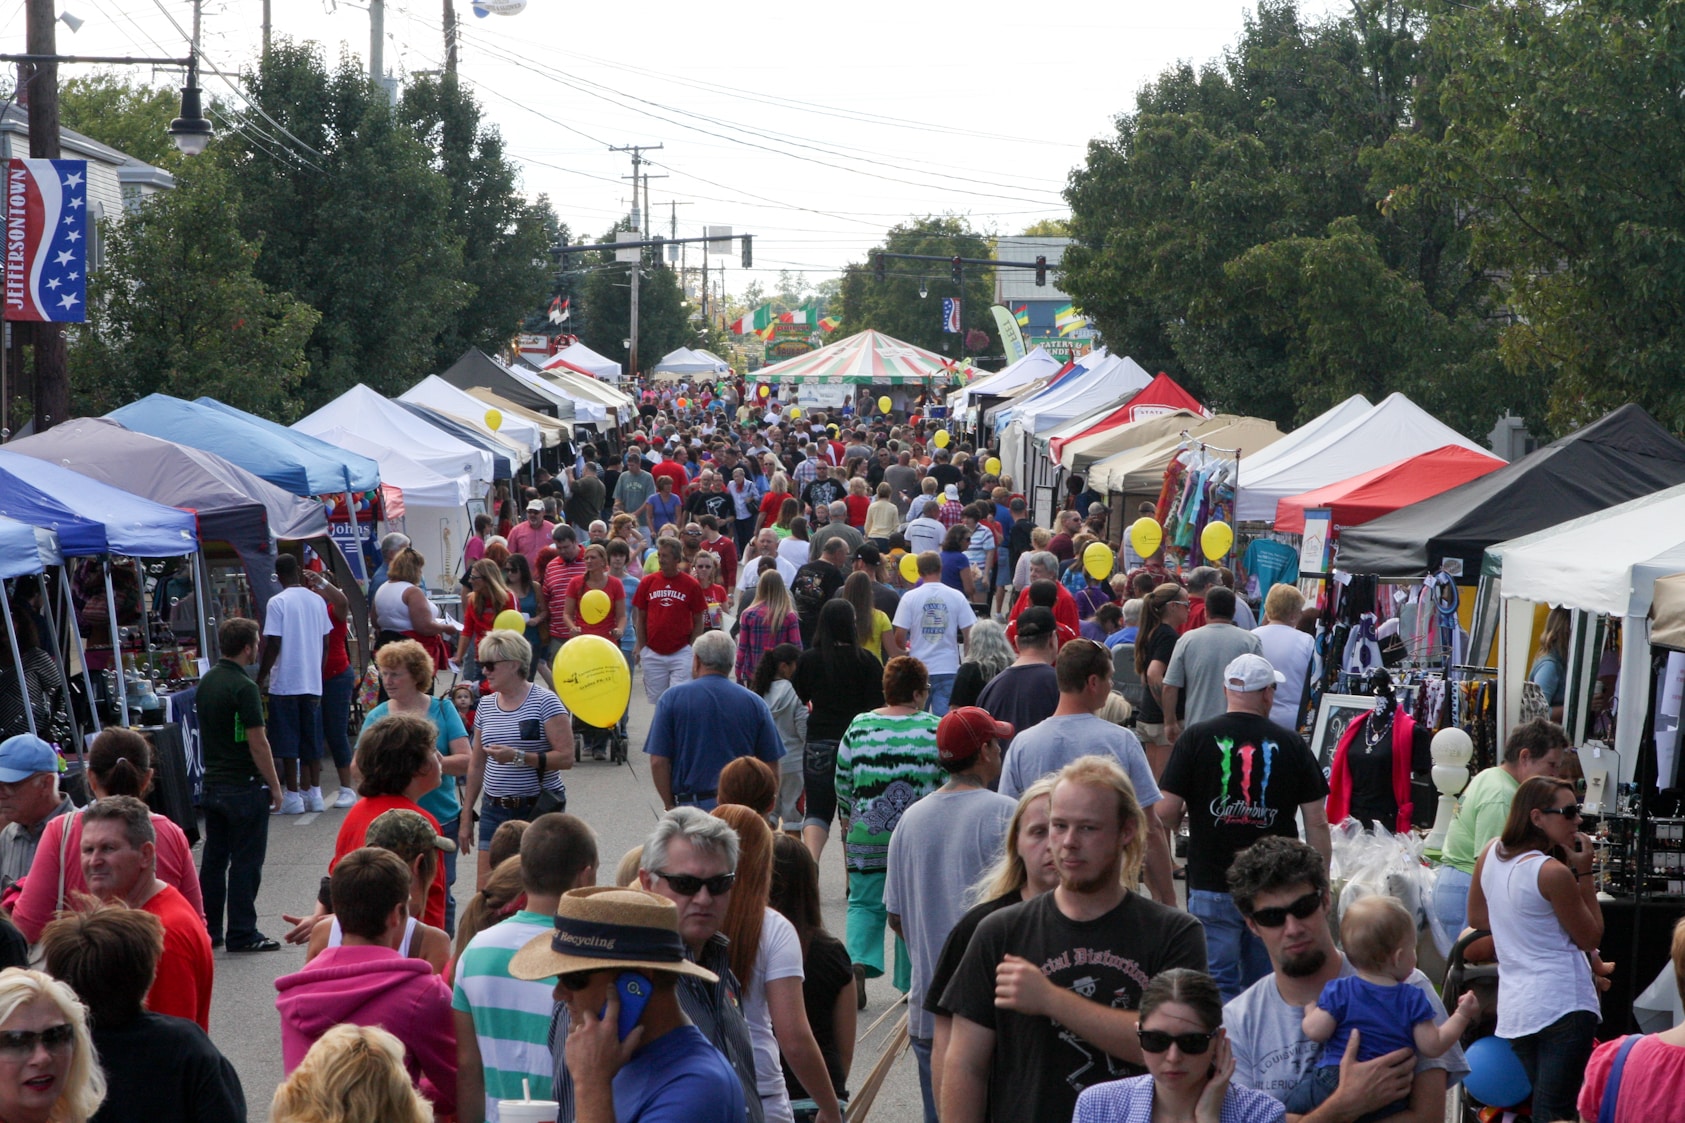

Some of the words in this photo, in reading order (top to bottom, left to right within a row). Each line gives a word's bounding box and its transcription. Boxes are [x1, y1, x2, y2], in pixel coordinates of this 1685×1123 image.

[6, 168, 27, 311] JEFFERSONTOWN
[649, 589, 686, 602] LOUISVILLE
[560, 930, 616, 949] Recycling
[1041, 950, 1071, 976] cial
[1073, 947, 1150, 990] Distortion
[1260, 1043, 1318, 1074] LOUISVILLE
